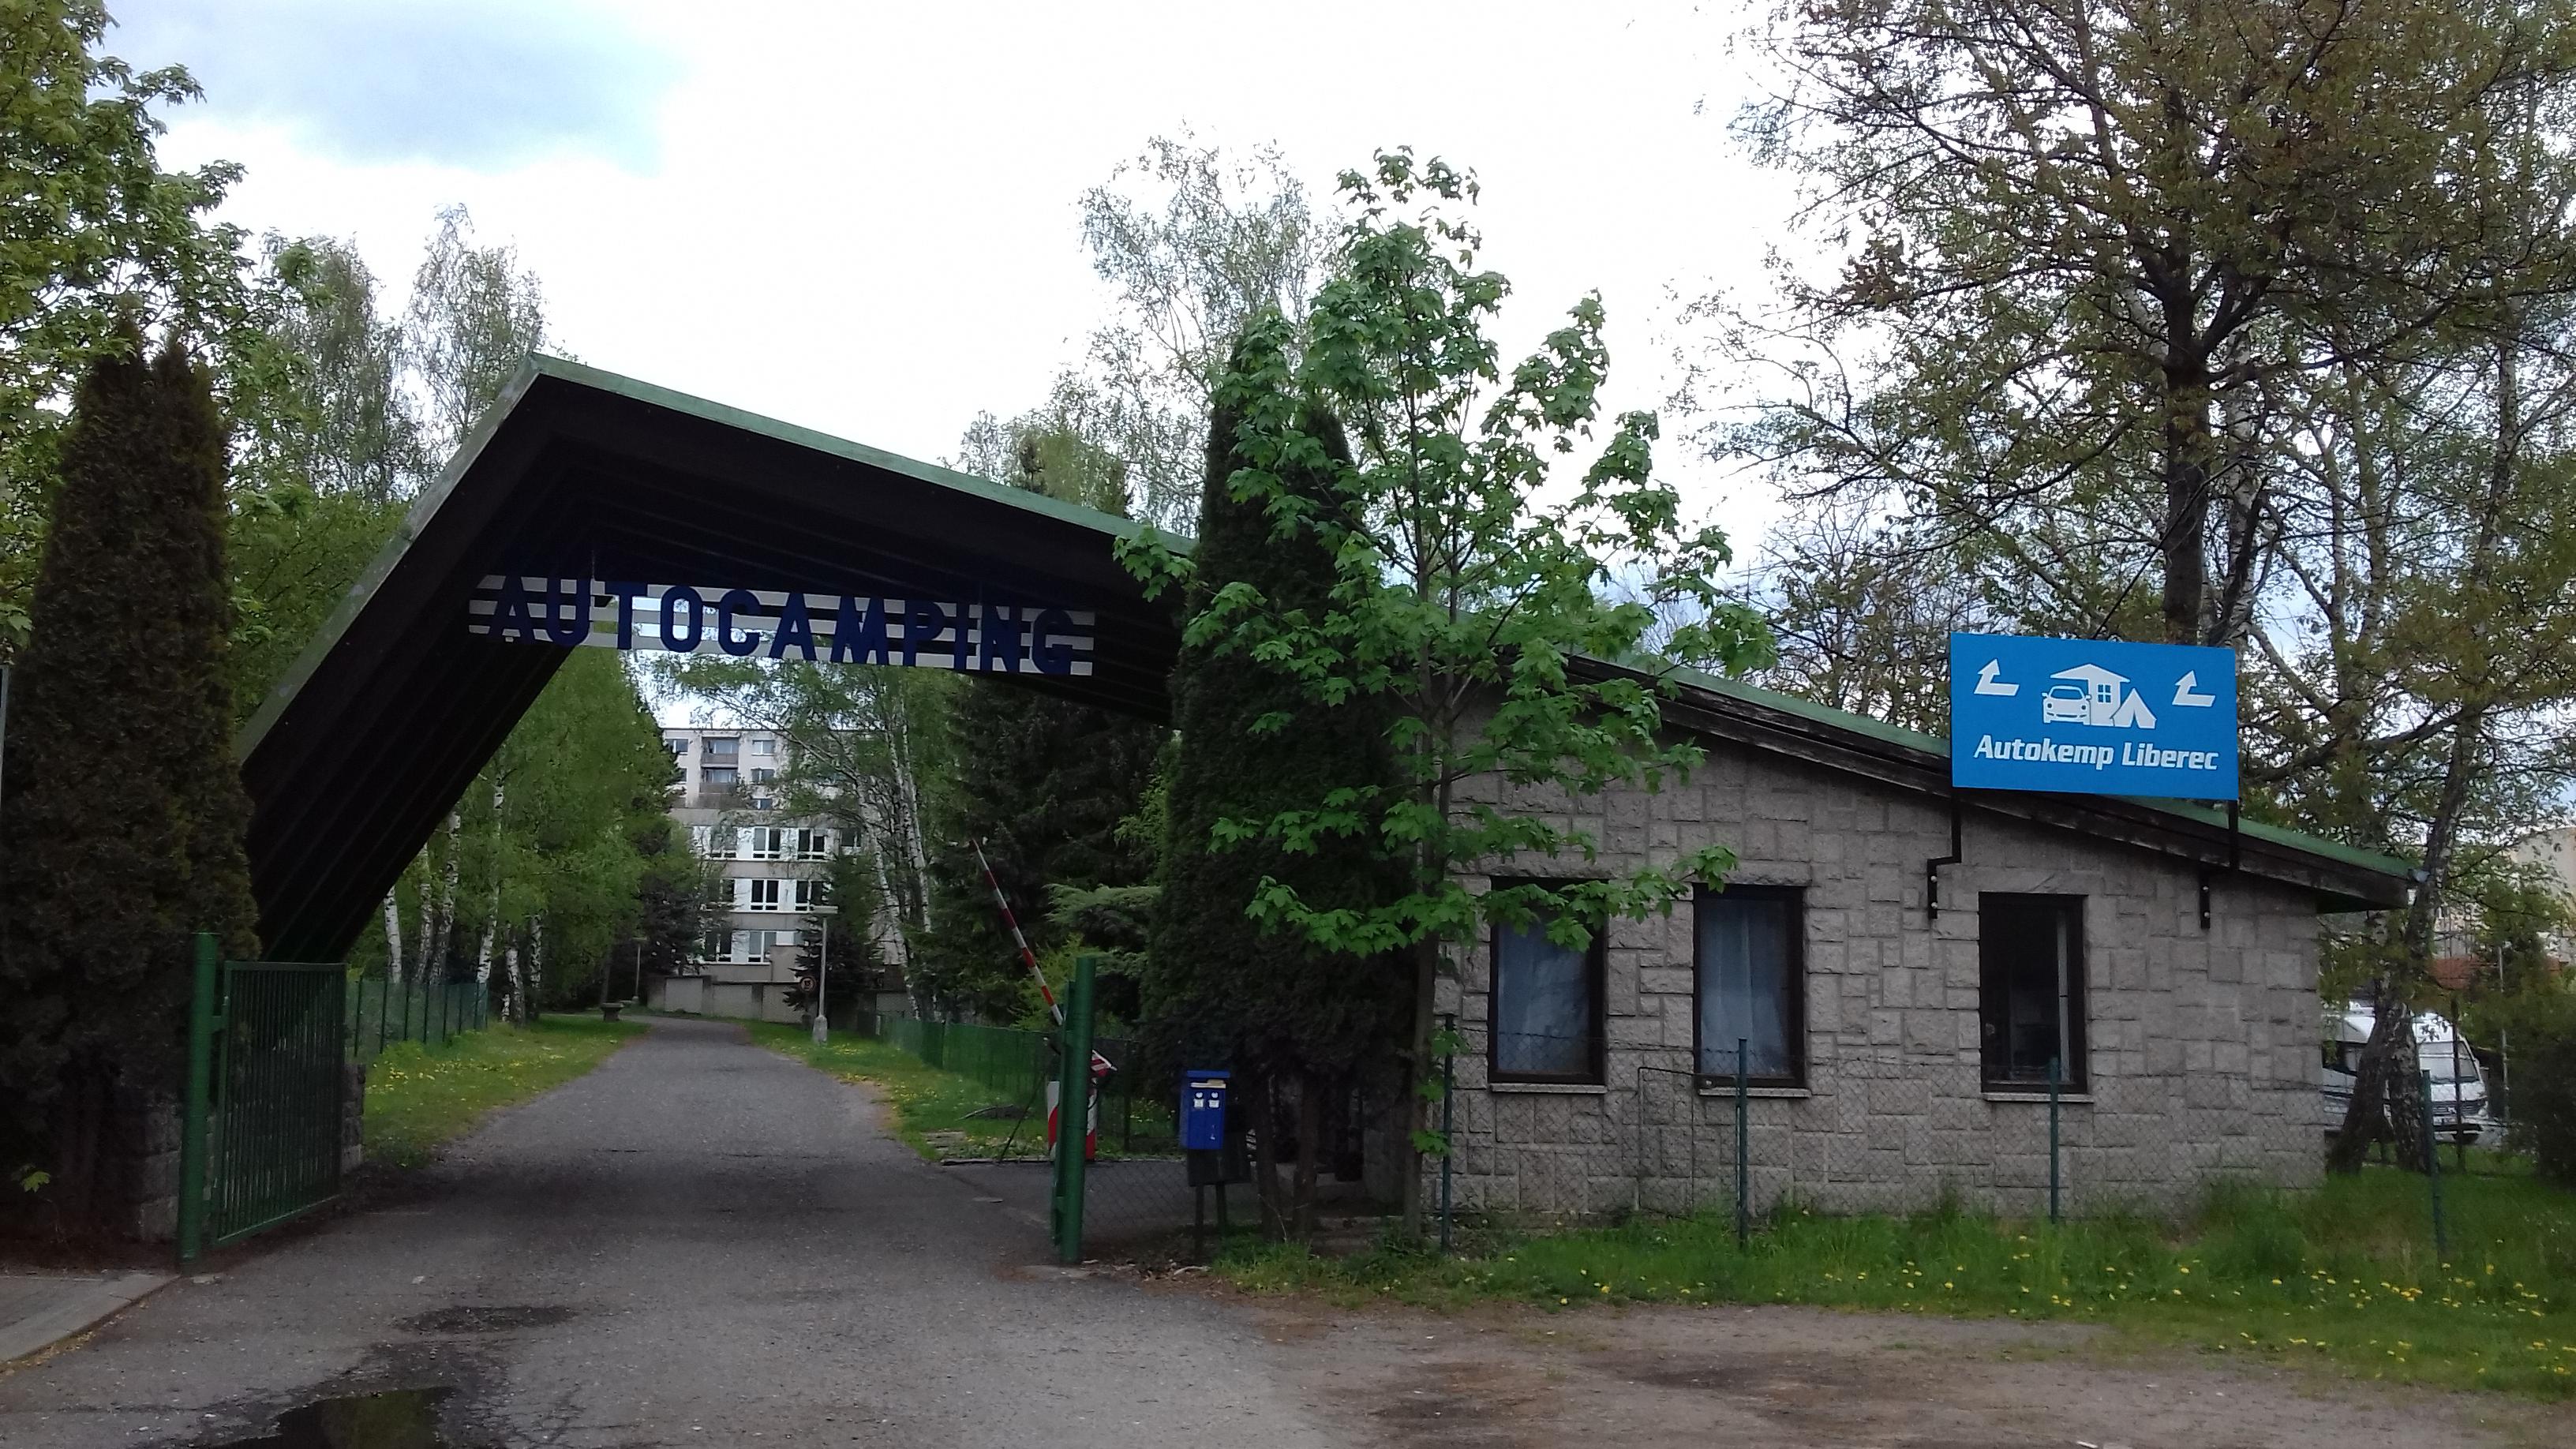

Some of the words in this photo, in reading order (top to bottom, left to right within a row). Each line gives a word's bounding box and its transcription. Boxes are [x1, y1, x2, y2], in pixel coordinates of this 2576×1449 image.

[487, 575, 1073, 676] AUTOCAMPING
[1973, 734, 2114, 770] Autokemp
[2121, 741, 2219, 770] Liberec
